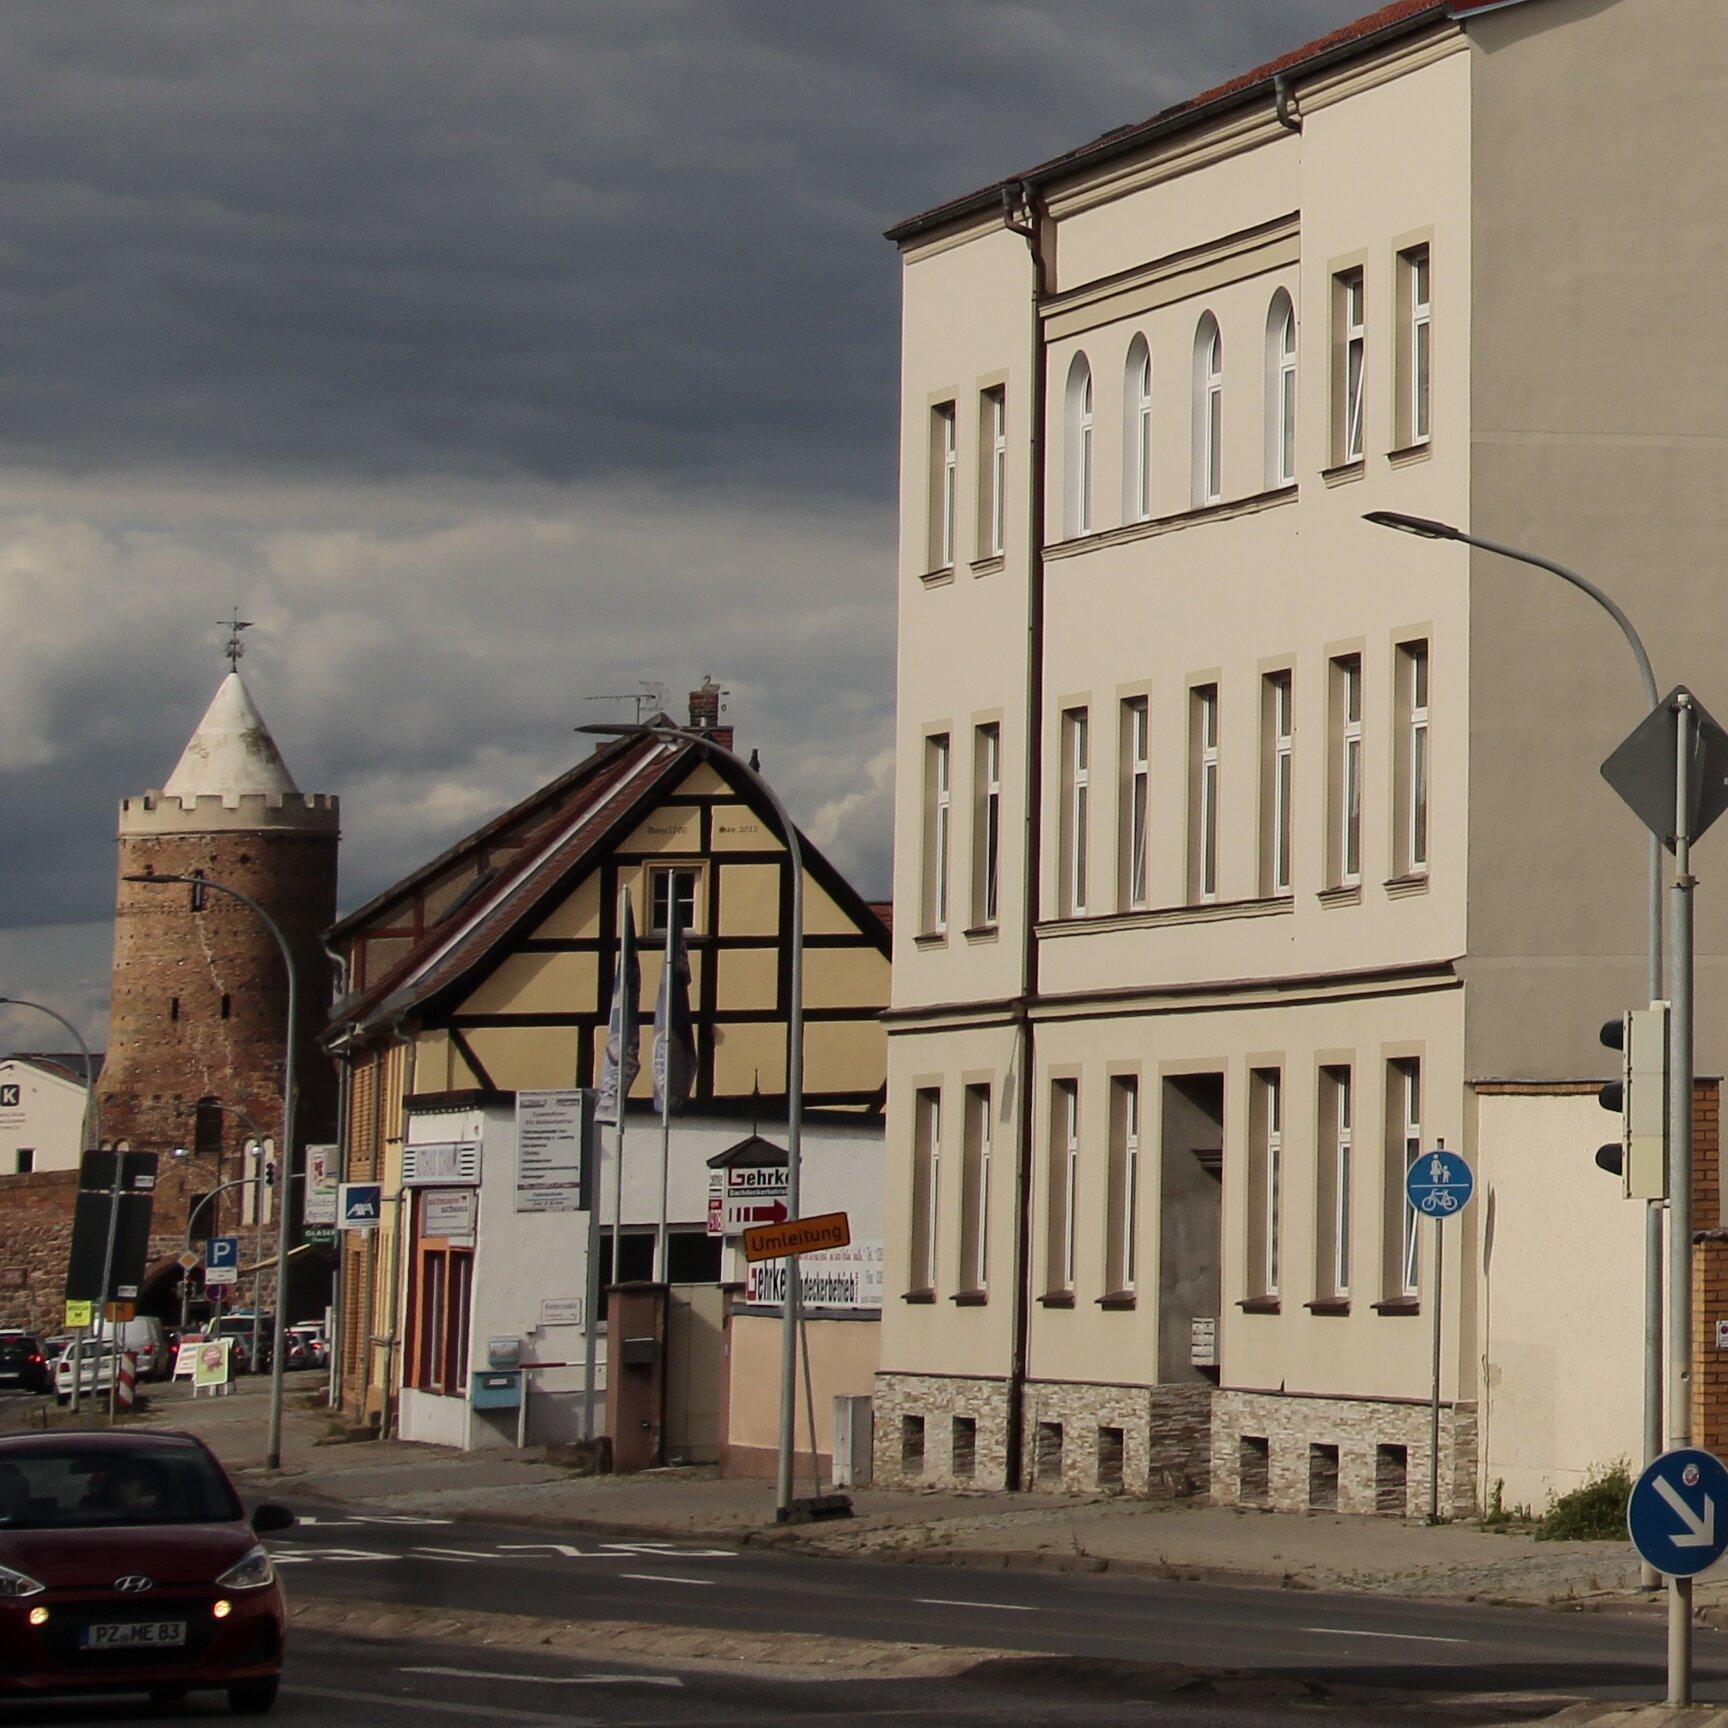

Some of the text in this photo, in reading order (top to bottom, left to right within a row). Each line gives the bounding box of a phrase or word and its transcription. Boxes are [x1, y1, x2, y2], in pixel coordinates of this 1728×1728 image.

[346, 1202, 374, 1217] AXA
[751, 1227, 842, 1252] Umleitung
[213, 1242, 231, 1265] P
[95, 1625, 119, 1643] PZ
